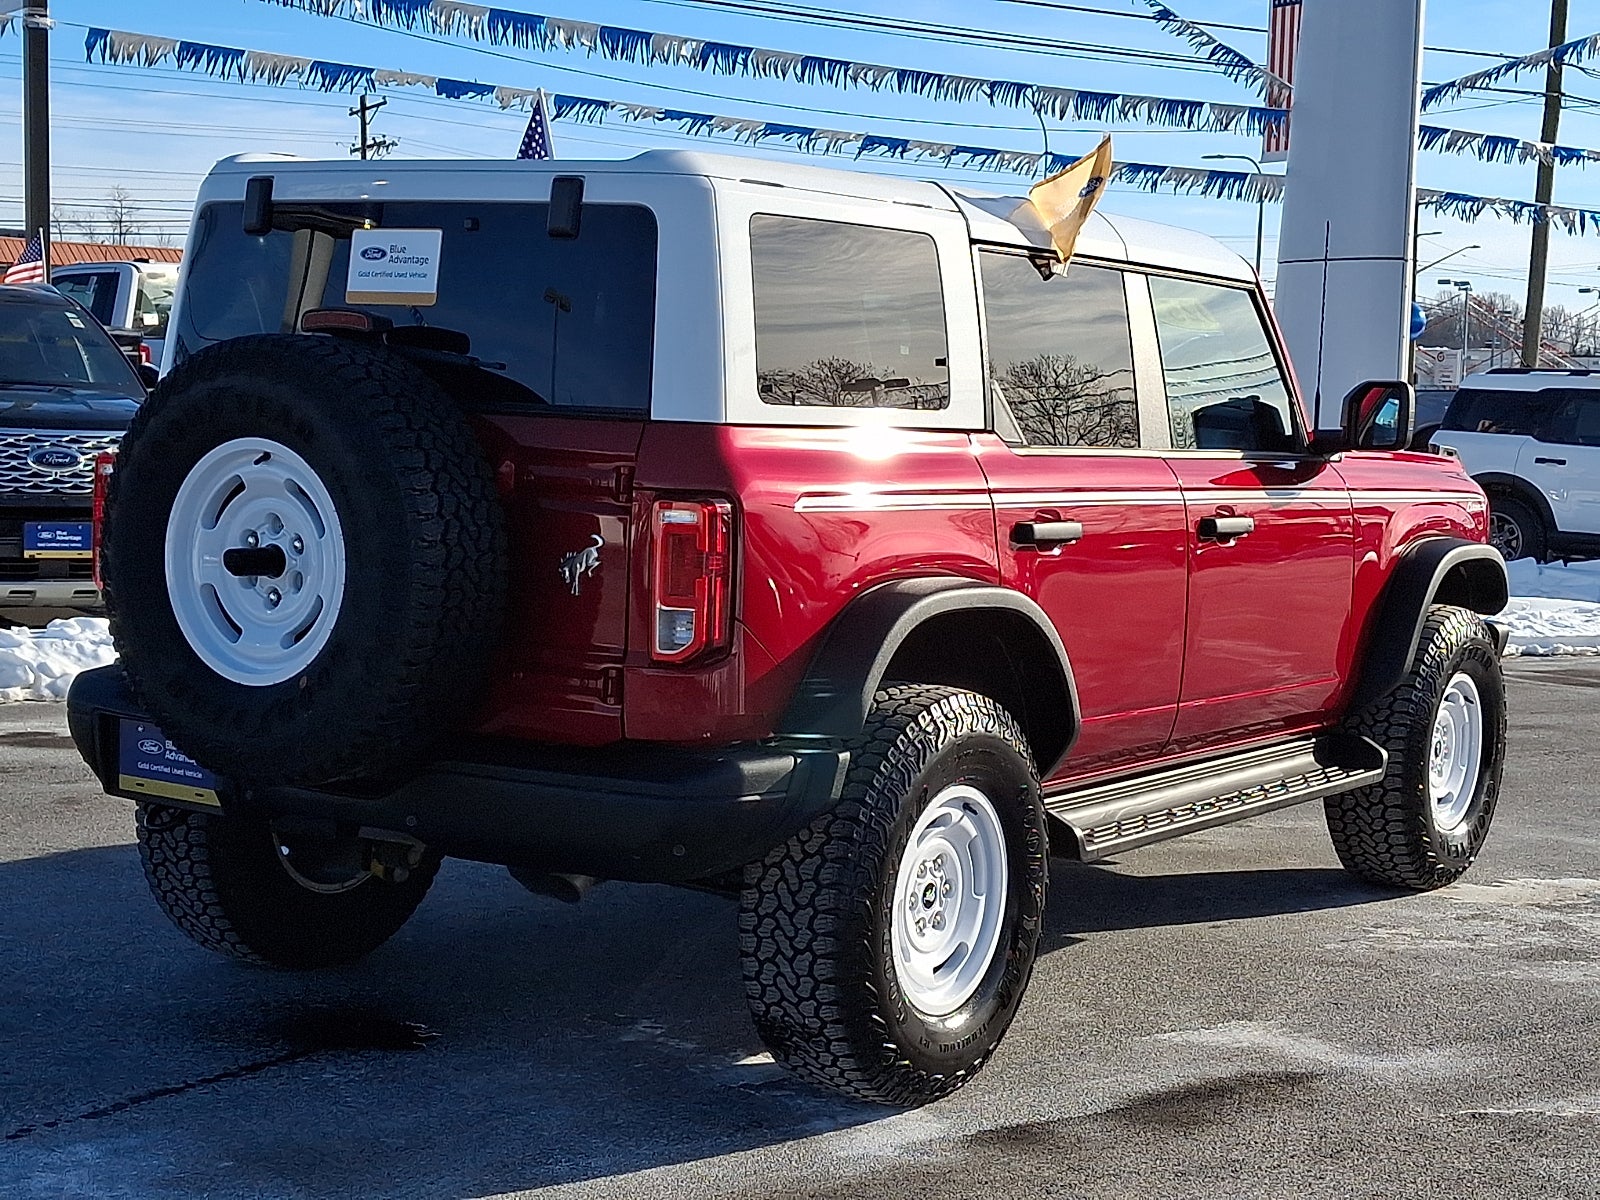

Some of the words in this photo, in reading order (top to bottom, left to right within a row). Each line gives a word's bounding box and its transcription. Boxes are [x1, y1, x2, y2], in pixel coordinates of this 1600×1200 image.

[389, 244, 407, 254] Blue
[388, 255, 430, 266] Advantage
[358, 270, 371, 278] Gold
[371, 270, 393, 278] Certified
[394, 271, 408, 279] Used
[408, 271, 428, 279] Vehicle
[137, 761, 150, 769] Gold
[150, 764, 171, 773] Certified
[171, 767, 184, 776] Used
[185, 769, 203, 779] Vehicle
